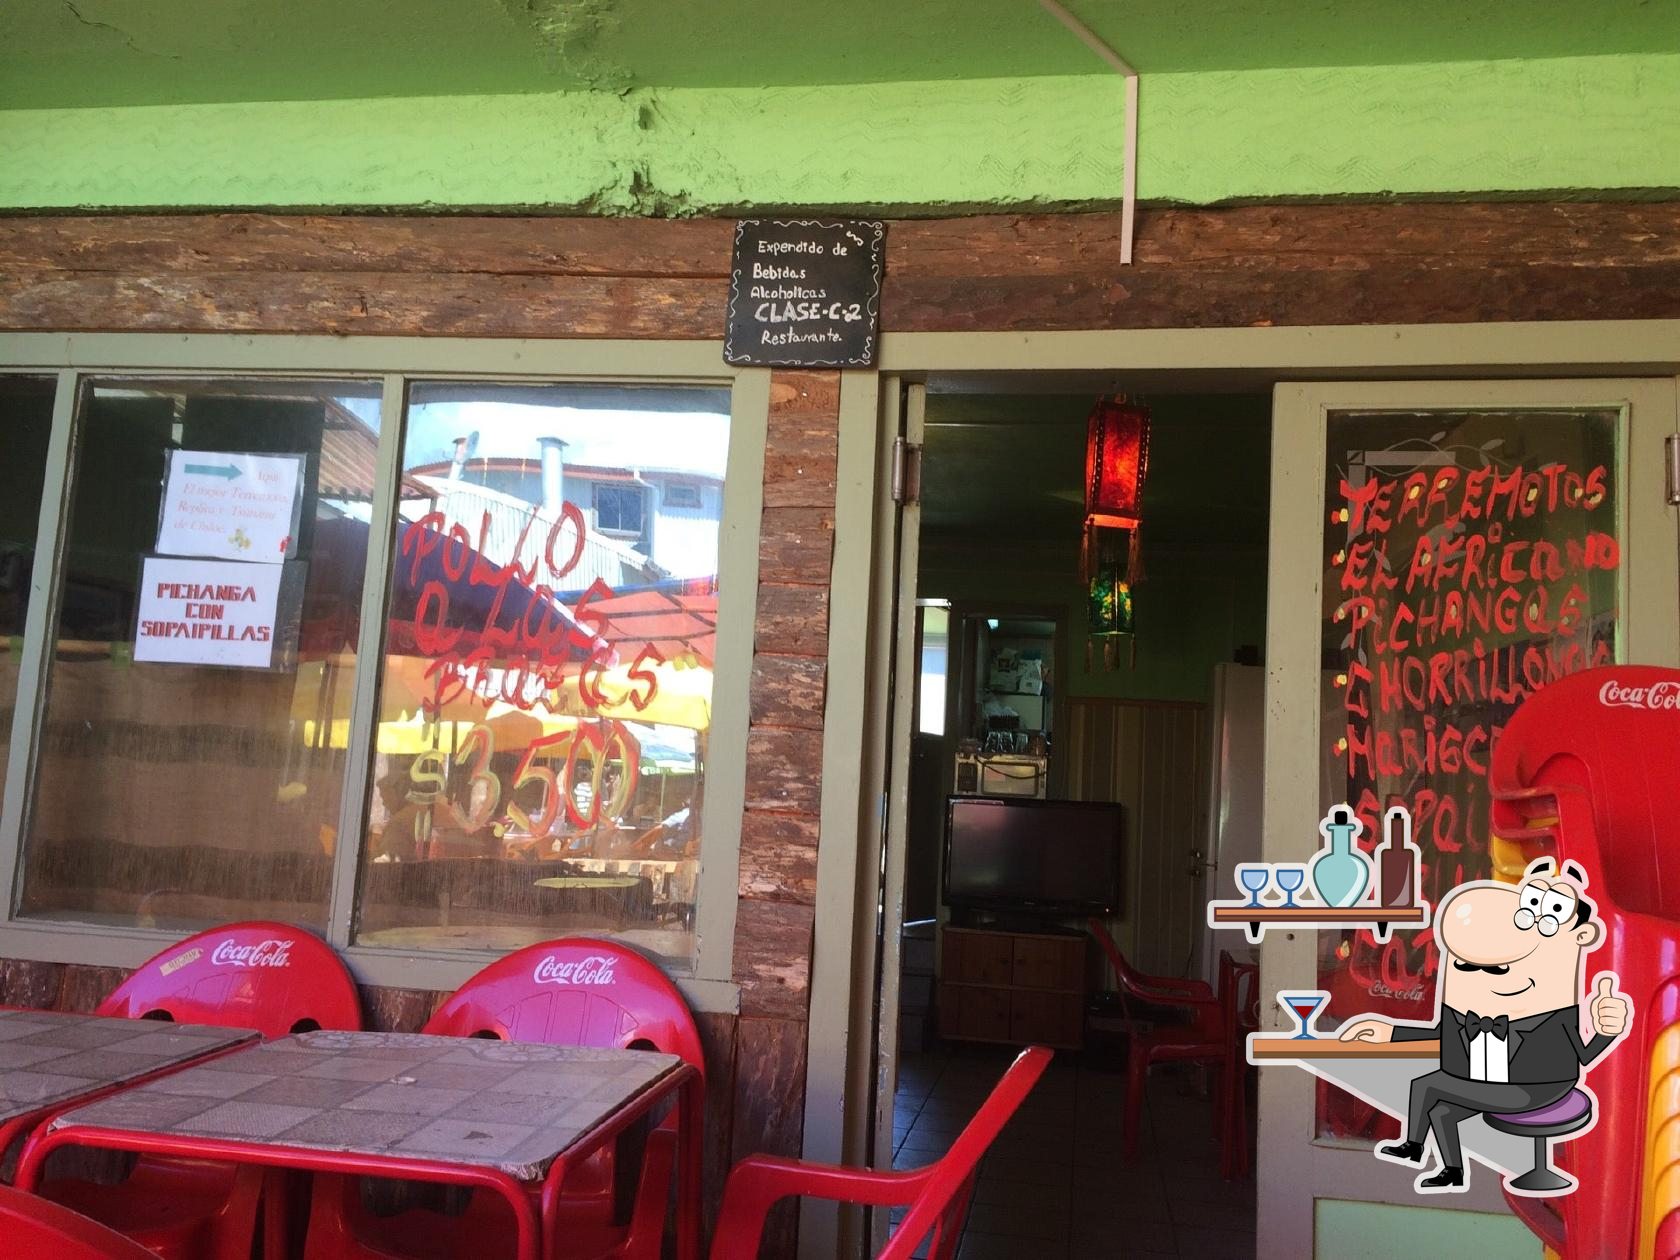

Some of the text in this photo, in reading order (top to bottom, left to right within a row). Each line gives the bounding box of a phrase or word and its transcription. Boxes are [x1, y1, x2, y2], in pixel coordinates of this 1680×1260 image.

[758, 240, 848, 256] Expendido de
[752, 263, 806, 280] Bebidas
[750, 284, 827, 300] Alcoholicas
[1341, 540, 1398, 597] EL
[157, 583, 256, 602] PICHANGA
[185, 603, 224, 619] CON
[140, 621, 270, 642] SOPAIPILLAS
[1599, 680, 1680, 709] Coca-Col
